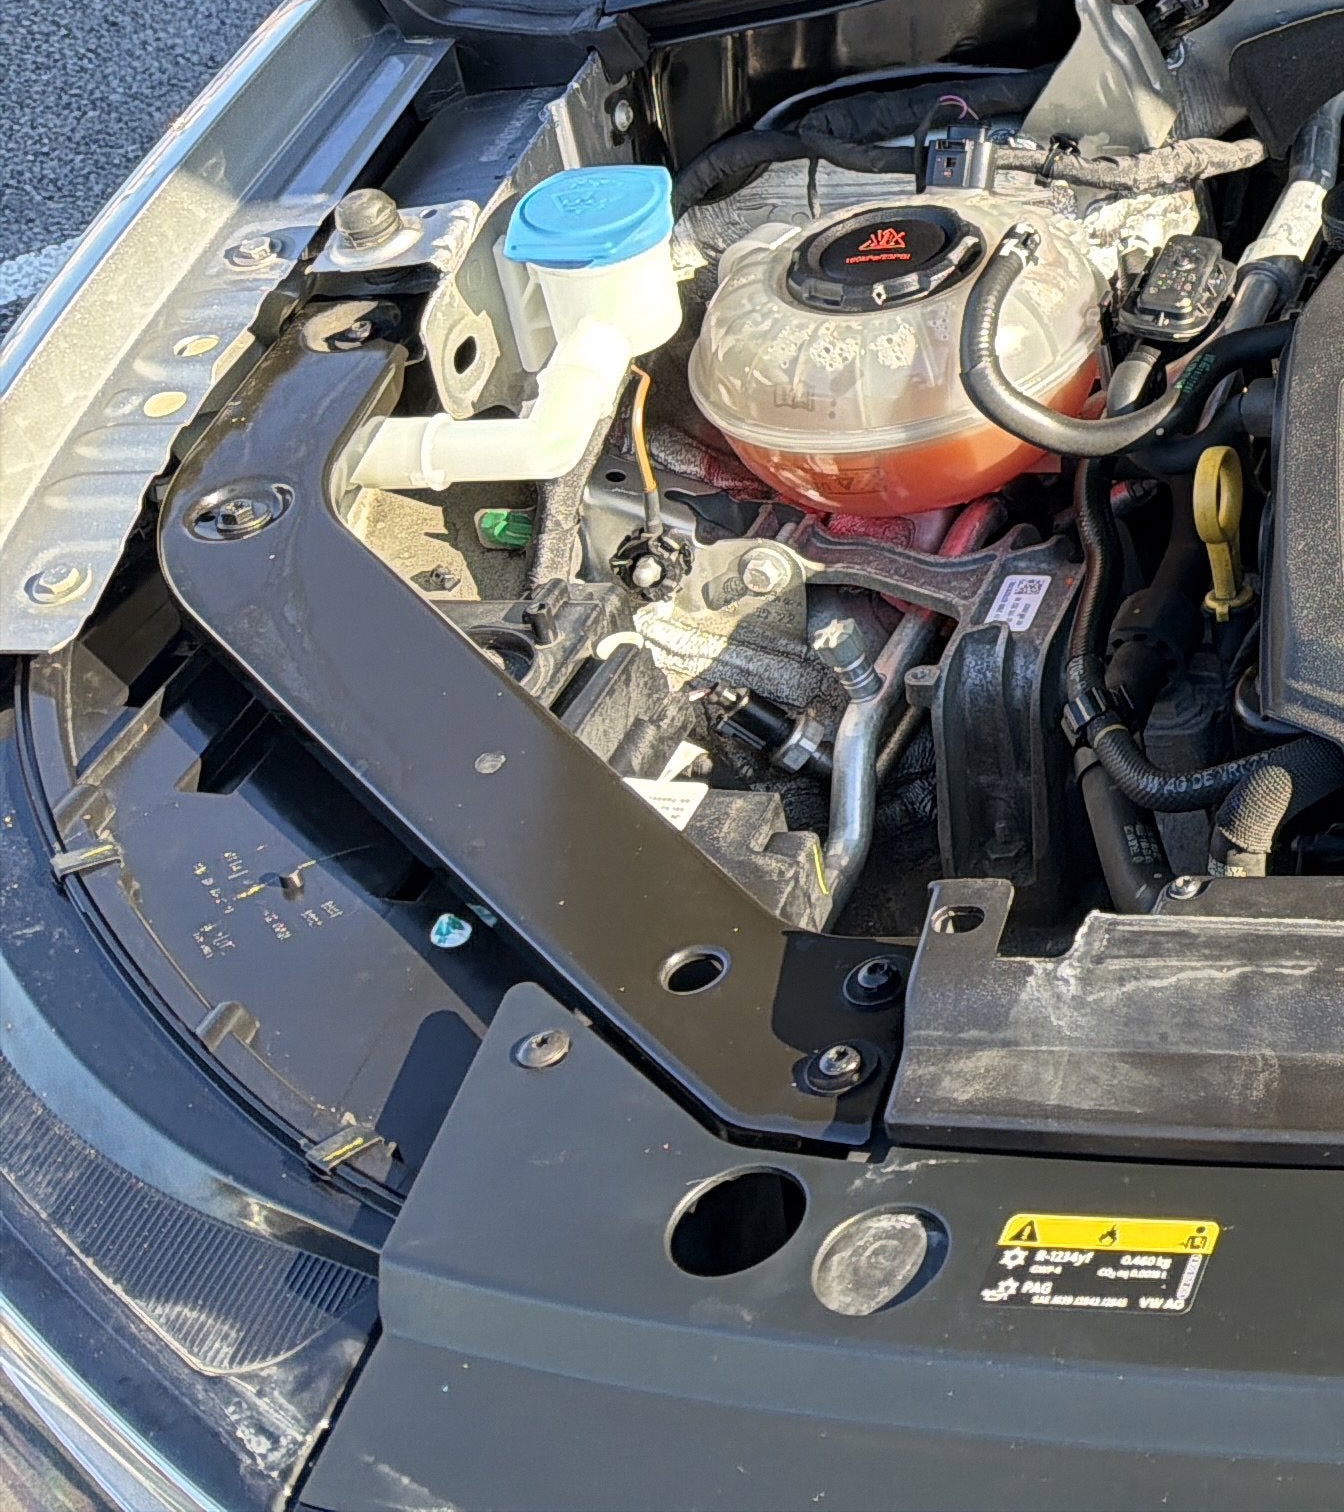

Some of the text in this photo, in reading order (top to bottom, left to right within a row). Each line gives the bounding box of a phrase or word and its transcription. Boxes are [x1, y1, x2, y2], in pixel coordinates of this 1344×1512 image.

[1164, 777, 1187, 794] AG
[1034, 1250, 1094, 1267] R-1234yf
[1156, 1257, 1172, 1269] kg
[1021, 1280, 1054, 1294] PAG
[1139, 1296, 1163, 1309] VW
[1165, 1298, 1185, 1310] AG
